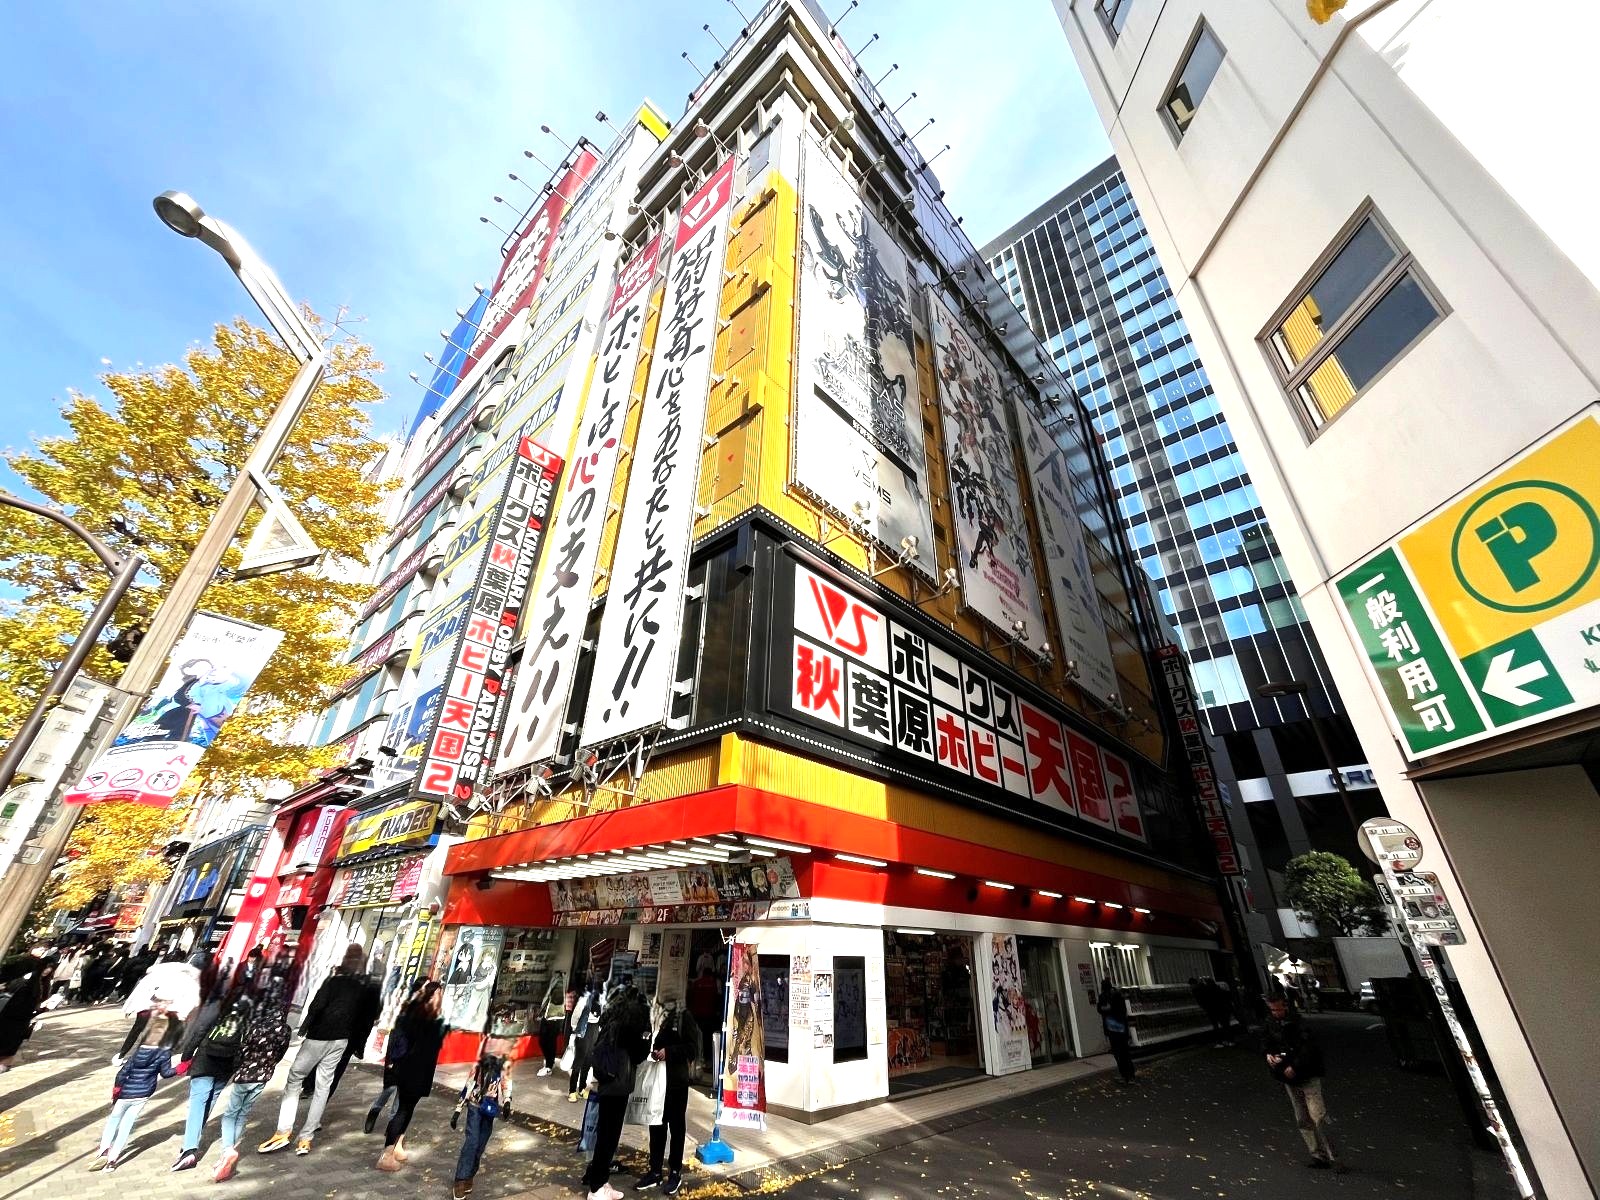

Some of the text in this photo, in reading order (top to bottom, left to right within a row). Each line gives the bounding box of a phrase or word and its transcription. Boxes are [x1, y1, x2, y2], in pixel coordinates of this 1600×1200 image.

[503, 325, 577, 413] FIGURE
[484, 391, 558, 478] VIDEO GAME
[453, 471, 556, 800] VOLKS AKIHABARA HOBBY PARADISE 2
[1356, 573, 1456, 732] 一般利用可
[894, 631, 1020, 737] ボークス
[376, 804, 434, 841] TRADER
[657, 908, 668, 922] 2F
